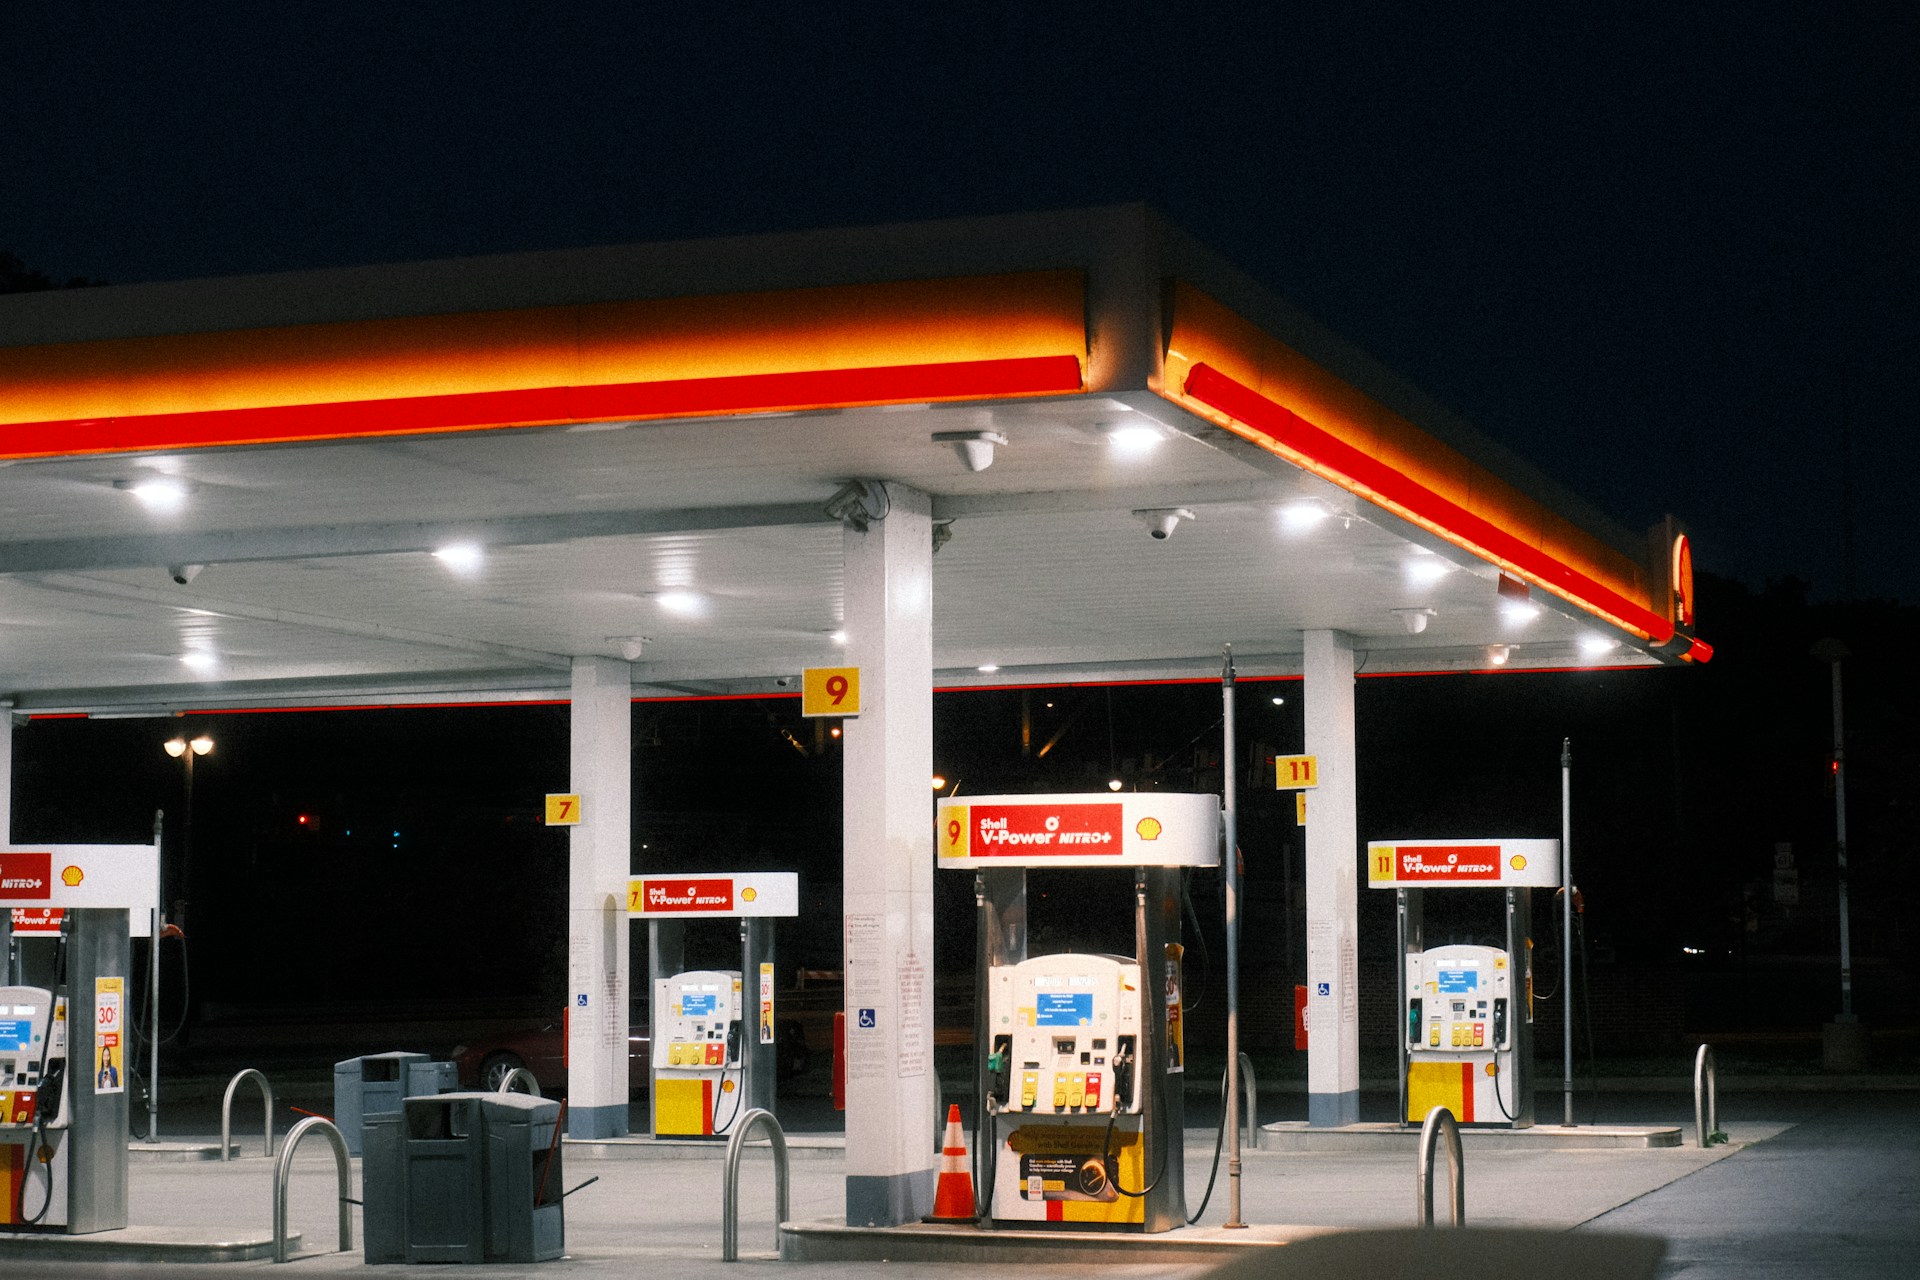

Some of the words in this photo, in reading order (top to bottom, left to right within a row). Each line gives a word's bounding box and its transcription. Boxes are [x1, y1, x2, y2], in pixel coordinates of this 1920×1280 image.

[826, 675, 849, 706] 9
[1289, 761, 1310, 781] 11
[559, 801, 572, 820] 7
[980, 817, 1008, 830] Shell
[947, 819, 961, 846] 9
[980, 830, 1056, 845] V-Power
[1378, 856, 1390, 873] 11
[1402, 854, 1422, 864] Shell
[1403, 863, 1456, 873] V-Power
[632, 891, 639, 907] 7
[649, 888, 666, 896] Shell
[649, 895, 693, 905] V-Power
